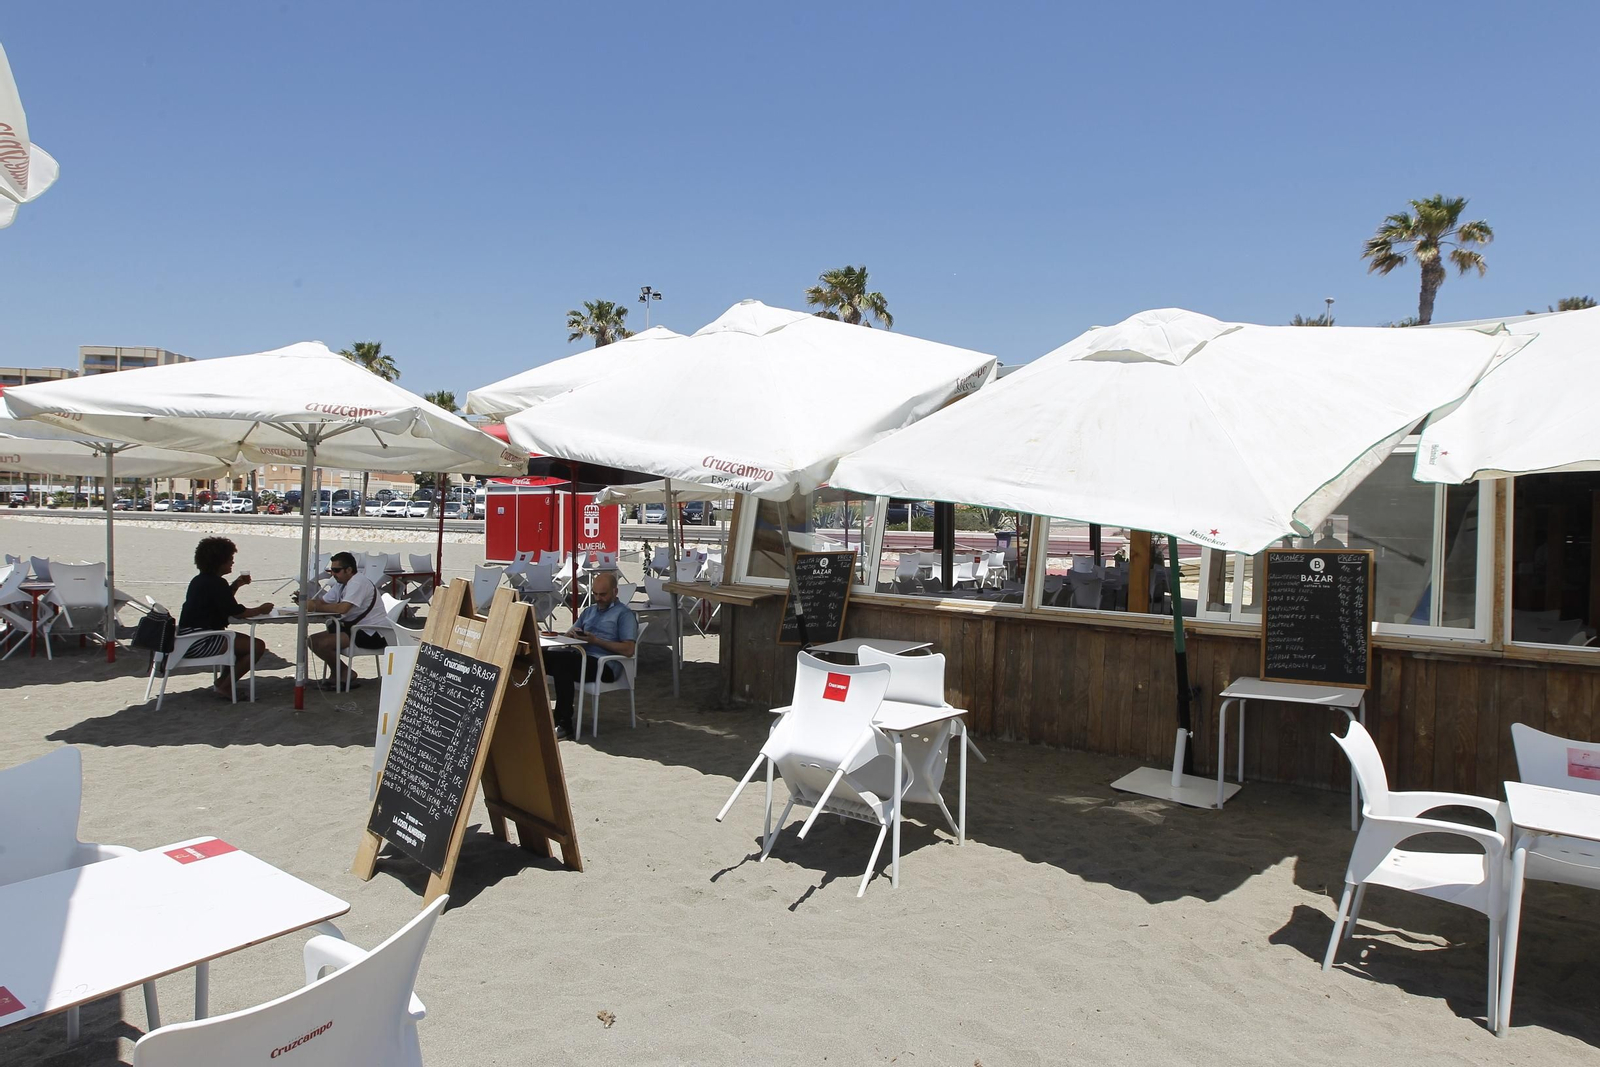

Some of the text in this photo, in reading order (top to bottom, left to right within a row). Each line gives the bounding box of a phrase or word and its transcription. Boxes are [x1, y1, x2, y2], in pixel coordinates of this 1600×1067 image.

[702, 455, 773, 482] Cruzcampo
[577, 541, 606, 550] ALMERÍA
[1189, 529, 1226, 546] Heineken
[1300, 574, 1333, 582] BAZAR
[420, 645, 445, 662] CARNES
[444, 657, 471, 675] Cruzcampo
[471, 663, 496, 681] BRASA
[437, 779, 448, 791] 15€
[452, 775, 464, 789] 15€
[448, 792, 458, 806] 15€
[428, 805, 441, 821] 15€
[270, 1020, 333, 1058] Cruzcampo
